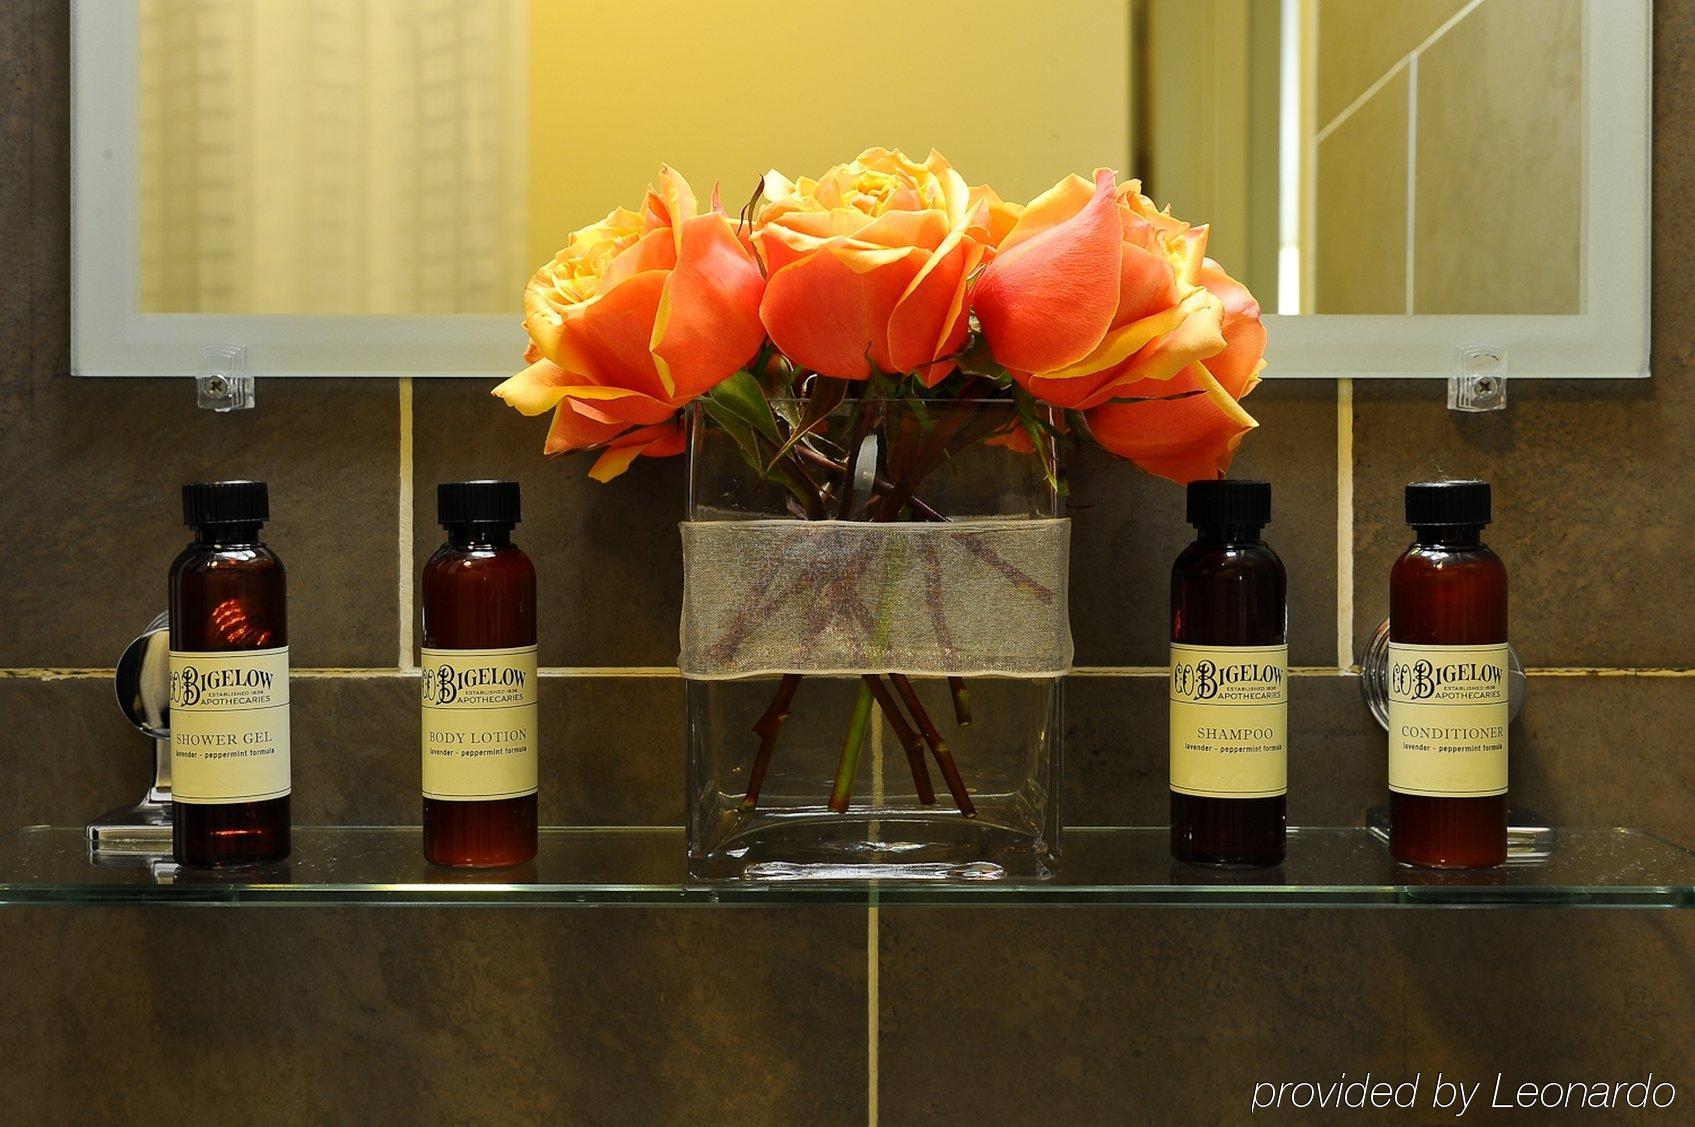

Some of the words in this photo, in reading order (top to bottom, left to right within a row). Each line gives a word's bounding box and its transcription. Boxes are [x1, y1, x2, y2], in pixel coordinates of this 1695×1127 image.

[436, 664, 526, 705] BIGELOW
[1193, 659, 1283, 700] BIGELOW
[1411, 659, 1502, 700] BIGELOW
[181, 666, 273, 707] BIGELOW
[200, 695, 270, 706] APOTHECARIES
[457, 694, 523, 704] APOTHECARIES
[1218, 691, 1281, 700] APOTHECARIES
[1435, 690, 1500, 699] APOTHECARIES
[430, 732, 465, 743] BODY
[471, 728, 527, 743] LOTION
[1197, 727, 1273, 740] SHAMPOO
[1401, 726, 1503, 739] CONDITIONER
[176, 734, 238, 746] SHOWER
[243, 732, 272, 744] GEL
[176, 750, 197, 758] lavender
[205, 750, 248, 759] peppermint
[250, 748, 274, 756] formula
[461, 748, 503, 757] peppermint
[505, 746, 527, 754] formula
[1185, 743, 1212, 752] lavender
[1220, 744, 1261, 753] peppermint
[1403, 742, 1430, 751] lavender
[1439, 744, 1481, 753] peppermint
